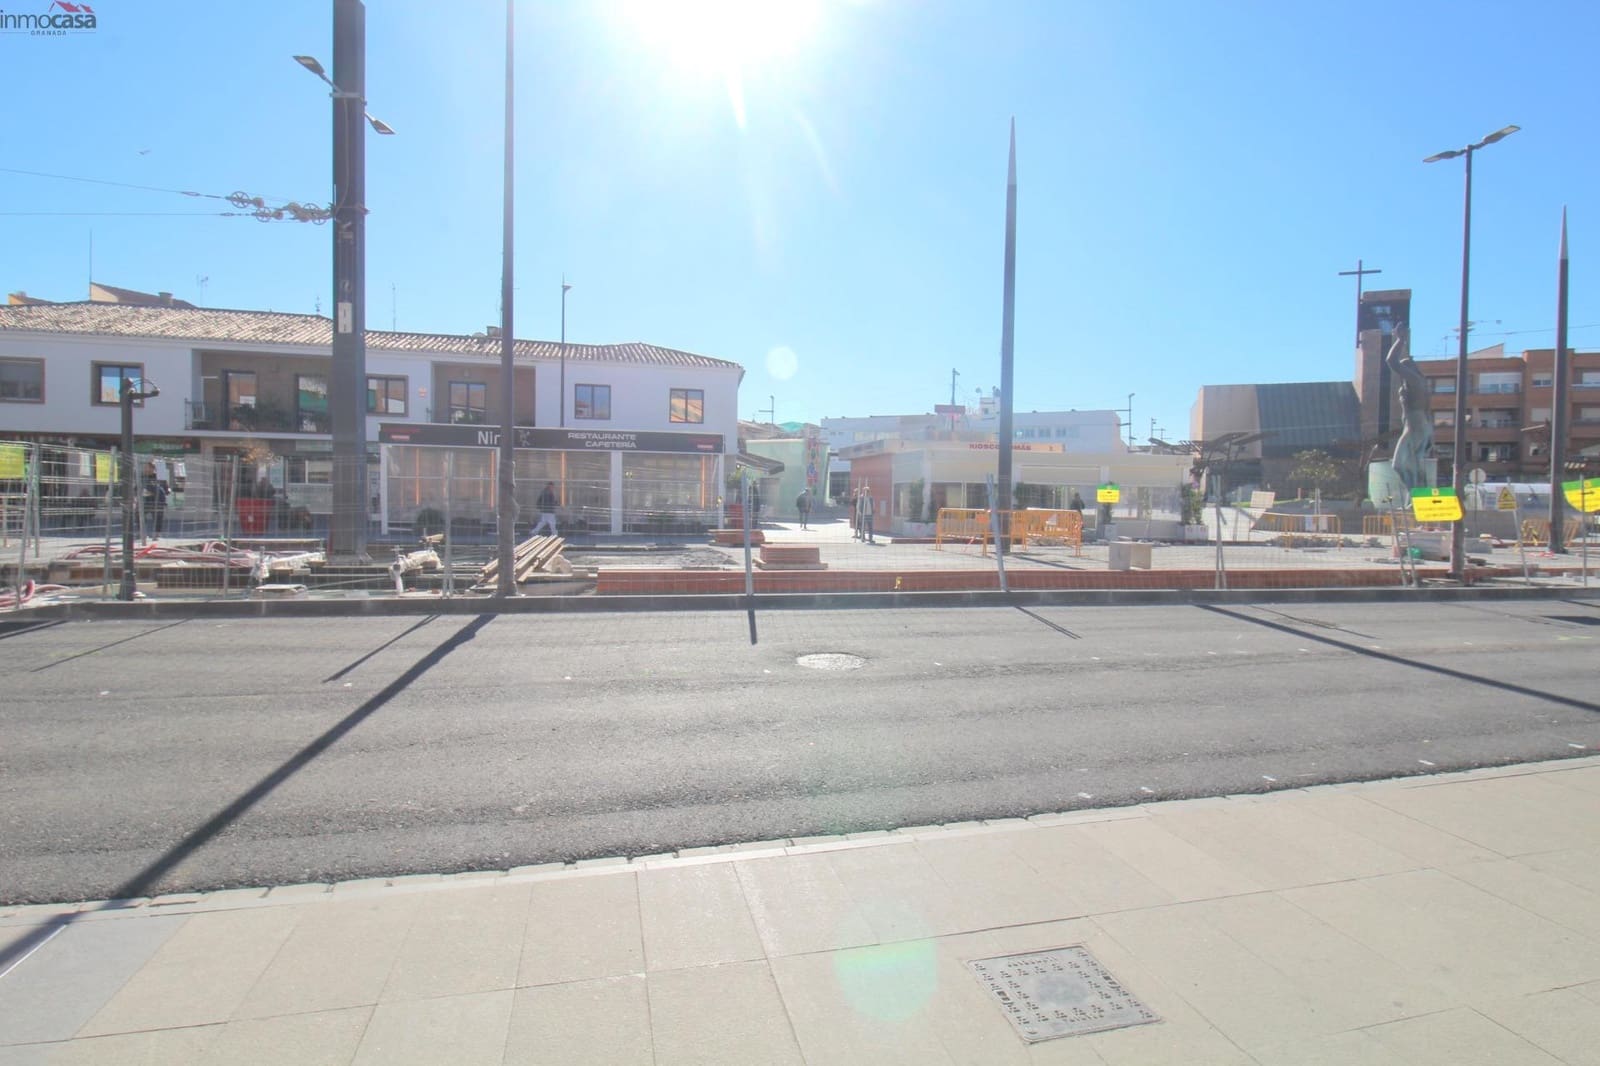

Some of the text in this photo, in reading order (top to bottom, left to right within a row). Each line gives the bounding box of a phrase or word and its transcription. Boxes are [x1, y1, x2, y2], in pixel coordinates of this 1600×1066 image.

[478, 430, 502, 445] Nir
[567, 432, 637, 441] RESTAURANTE
[585, 440, 637, 449] CAFETERÍA
